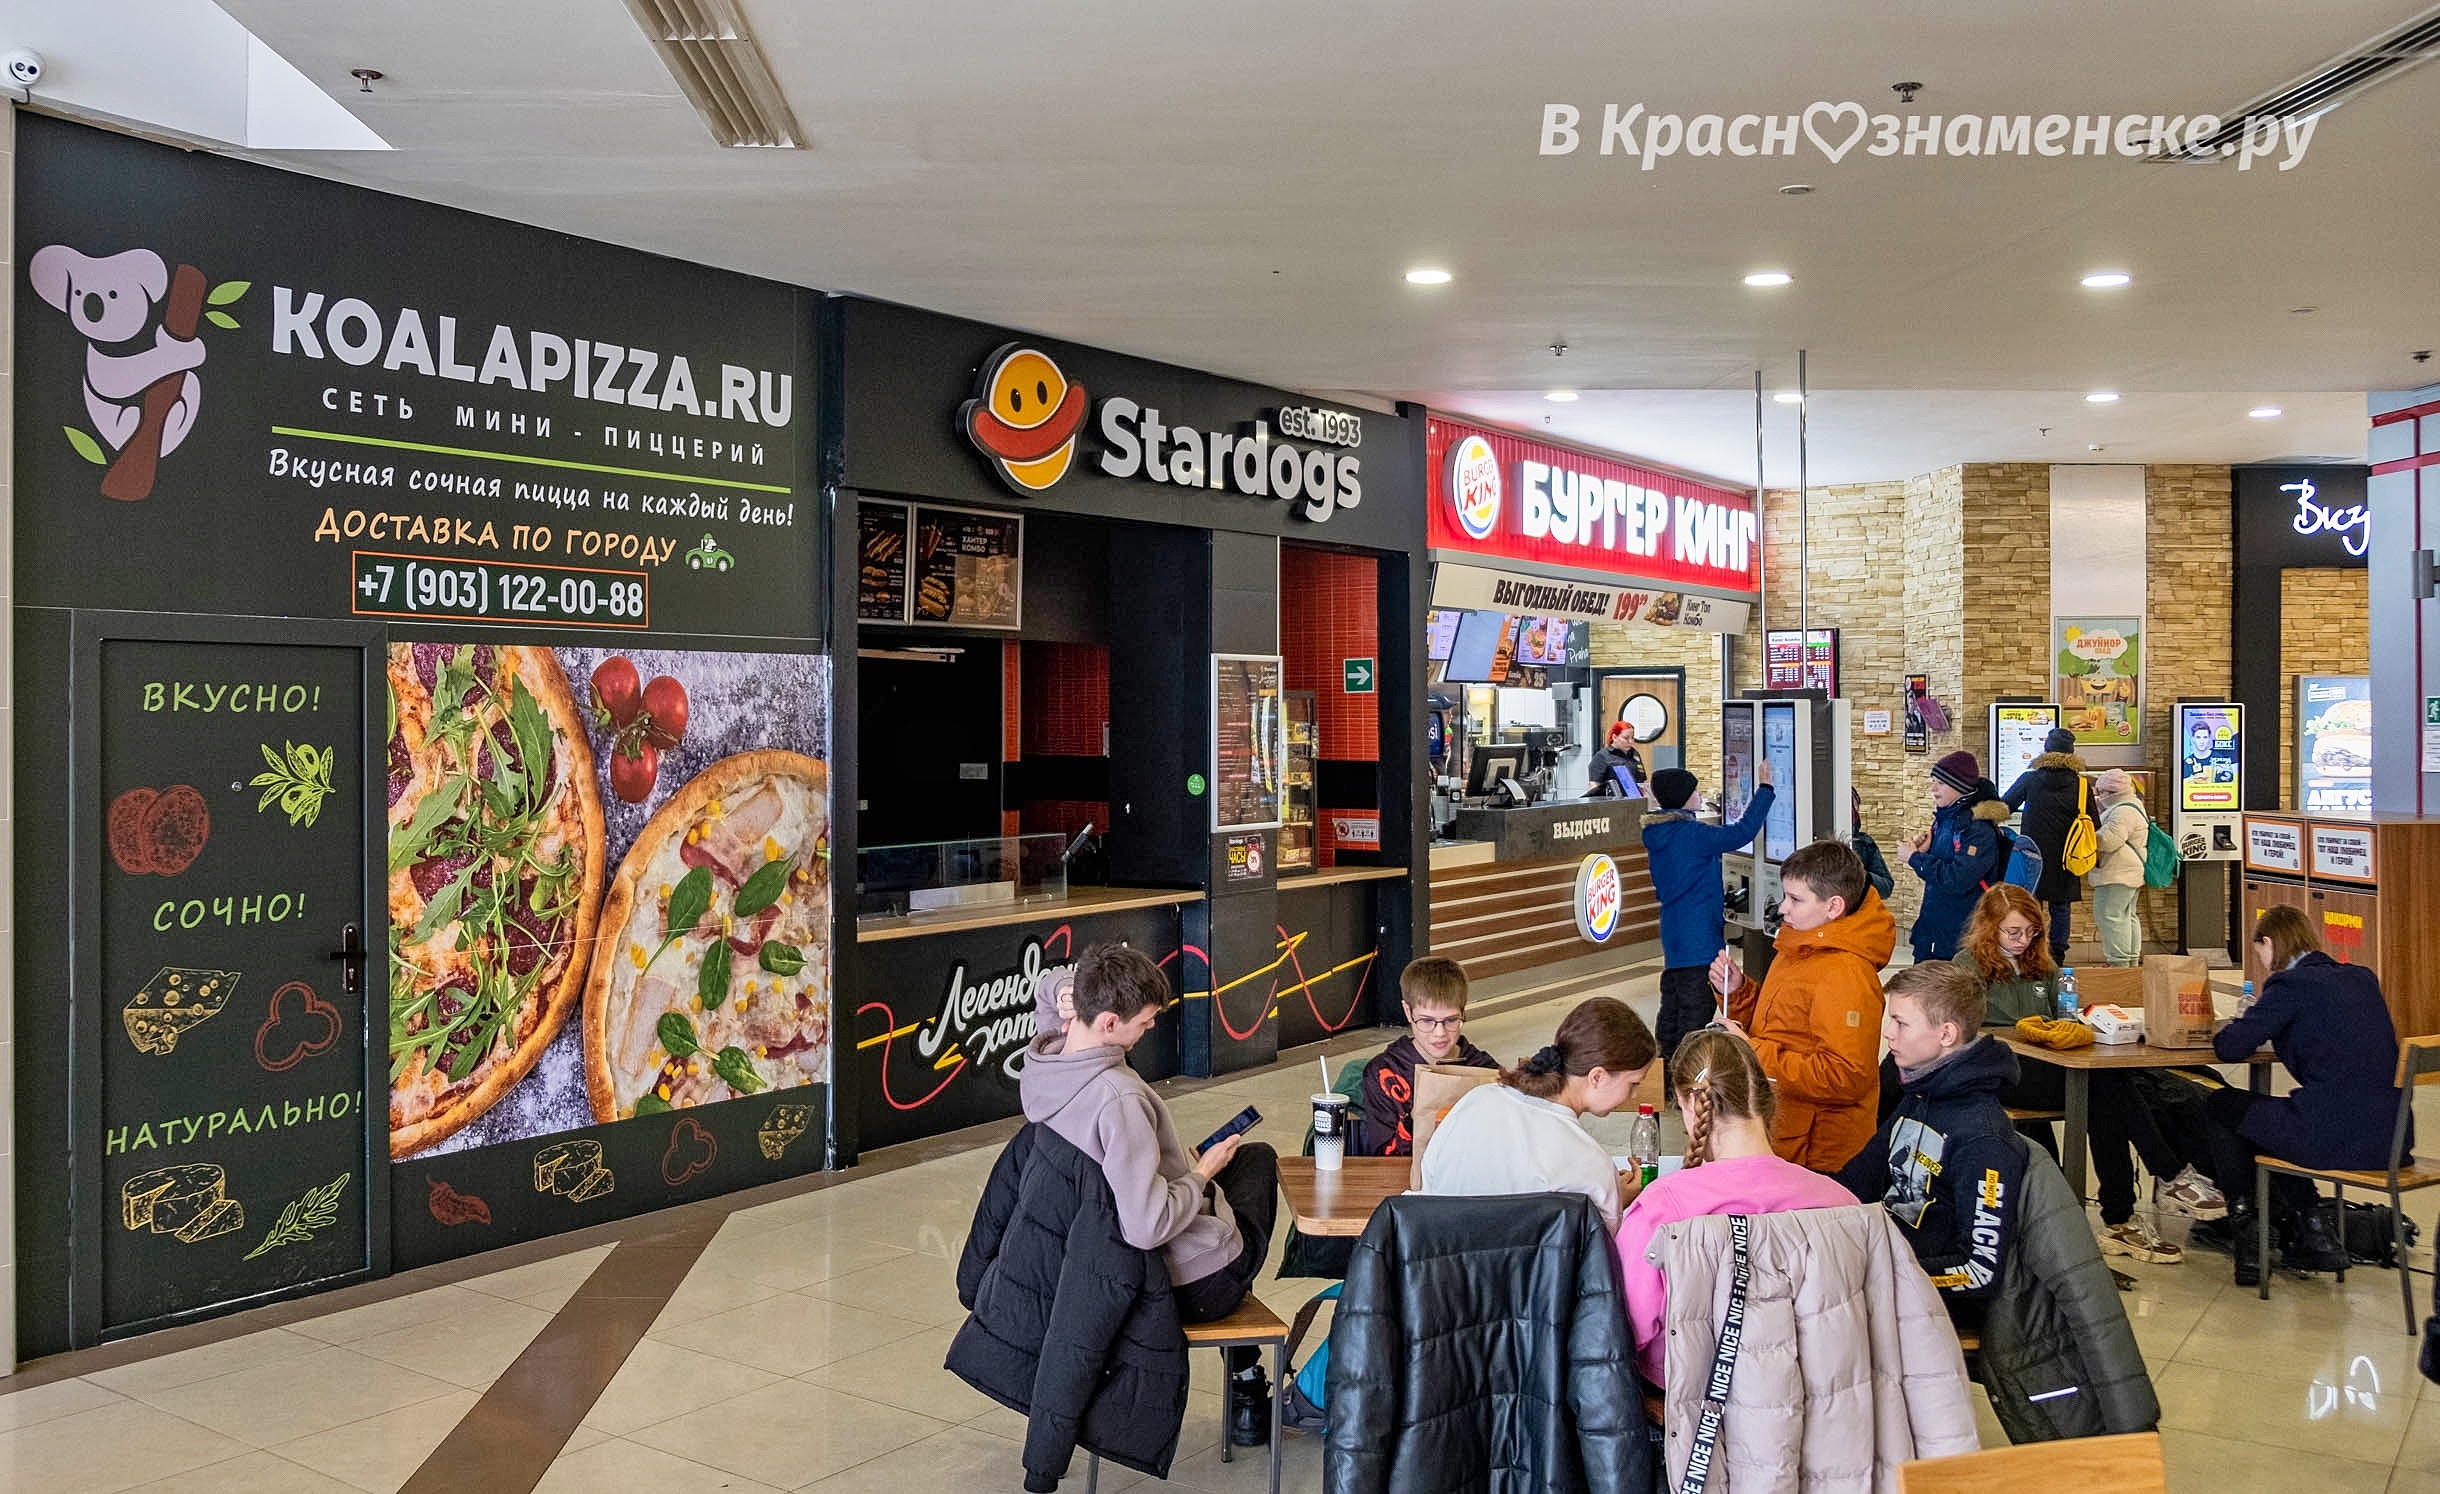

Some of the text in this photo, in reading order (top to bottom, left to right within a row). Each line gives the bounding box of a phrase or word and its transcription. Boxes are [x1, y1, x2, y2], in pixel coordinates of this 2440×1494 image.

[272, 285, 793, 428] KOALAPIZZA.RU
[321, 388, 415, 420] СЕТЬ
[456, 404, 552, 438] МИНИ
[604, 424, 768, 467] ПИЦЦЕРИЙ
[1279, 406, 1361, 447] est. 1993
[1100, 397, 1362, 522] Stardogs
[269, 448, 794, 527] Вкусная сочная пицца на каждый день!
[1522, 460, 1756, 573] БУРГЕР КИНГ
[314, 507, 677, 567] ДОСТАВКА ПО ГОРОДУ
[358, 562, 644, 618] +7 (903) 122-00-88
[1493, 579, 1574, 613] ВЫГОДНЫЙ
[1571, 589, 1611, 616] ОБЕД!
[143, 683, 322, 713] ВКУСНО!
[1553, 817, 1610, 840] выдача
[2183, 843, 2207, 858] KING
[1588, 869, 1614, 904] BURGER
[1589, 884, 1615, 925] KING
[153, 893, 306, 931] СОЧНО!
[105, 1090, 364, 1157] НАТУРАЛЬНО!
[1731, 1218, 1747, 1251] NICE
[1972, 1180, 2005, 1264] BLACK
[1718, 1325, 1740, 1362] NICE
[1710, 1363, 1733, 1400] NICE
[1697, 1409, 1721, 1444] NICE
[1687, 1443, 1712, 1482] NICE
